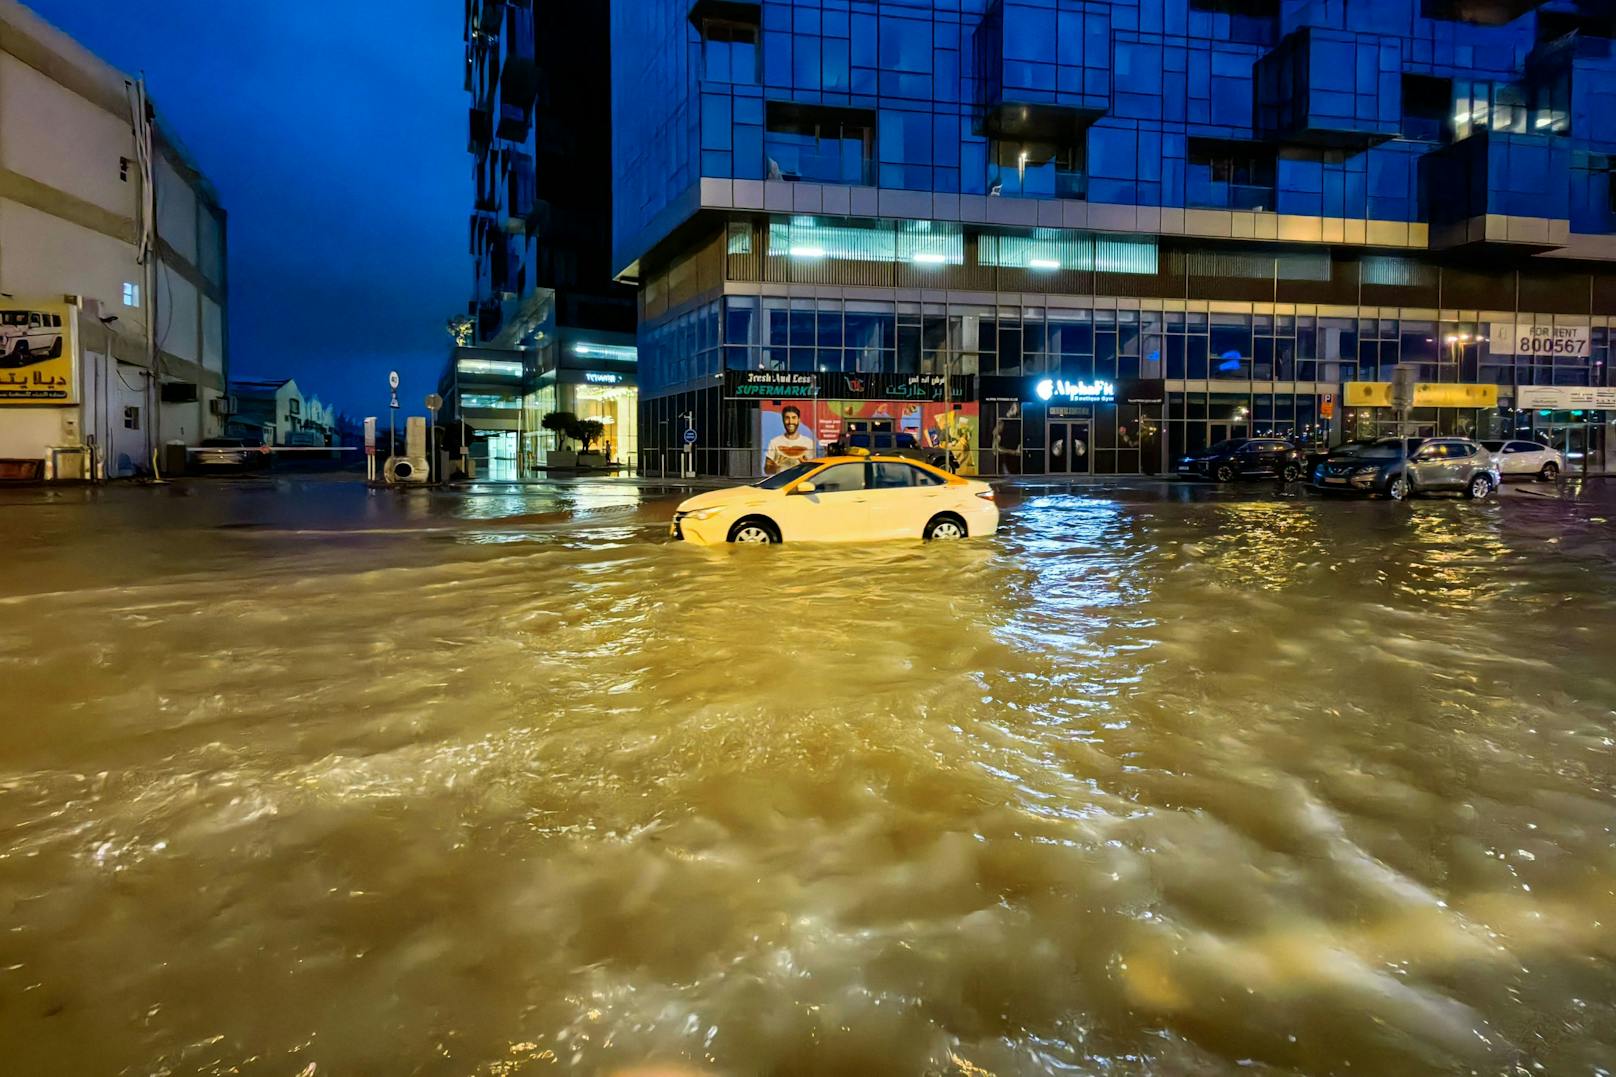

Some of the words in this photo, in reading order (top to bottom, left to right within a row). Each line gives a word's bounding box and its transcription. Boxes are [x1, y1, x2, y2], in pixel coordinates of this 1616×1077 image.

[1530, 327, 1549, 336] FOR
[1553, 328, 1577, 337] RENT
[1520, 337, 1586, 353] 800567
[748, 373, 771, 383] Fresh
[772, 373, 791, 383] And
[736, 384, 821, 396] SUPERMARKET
